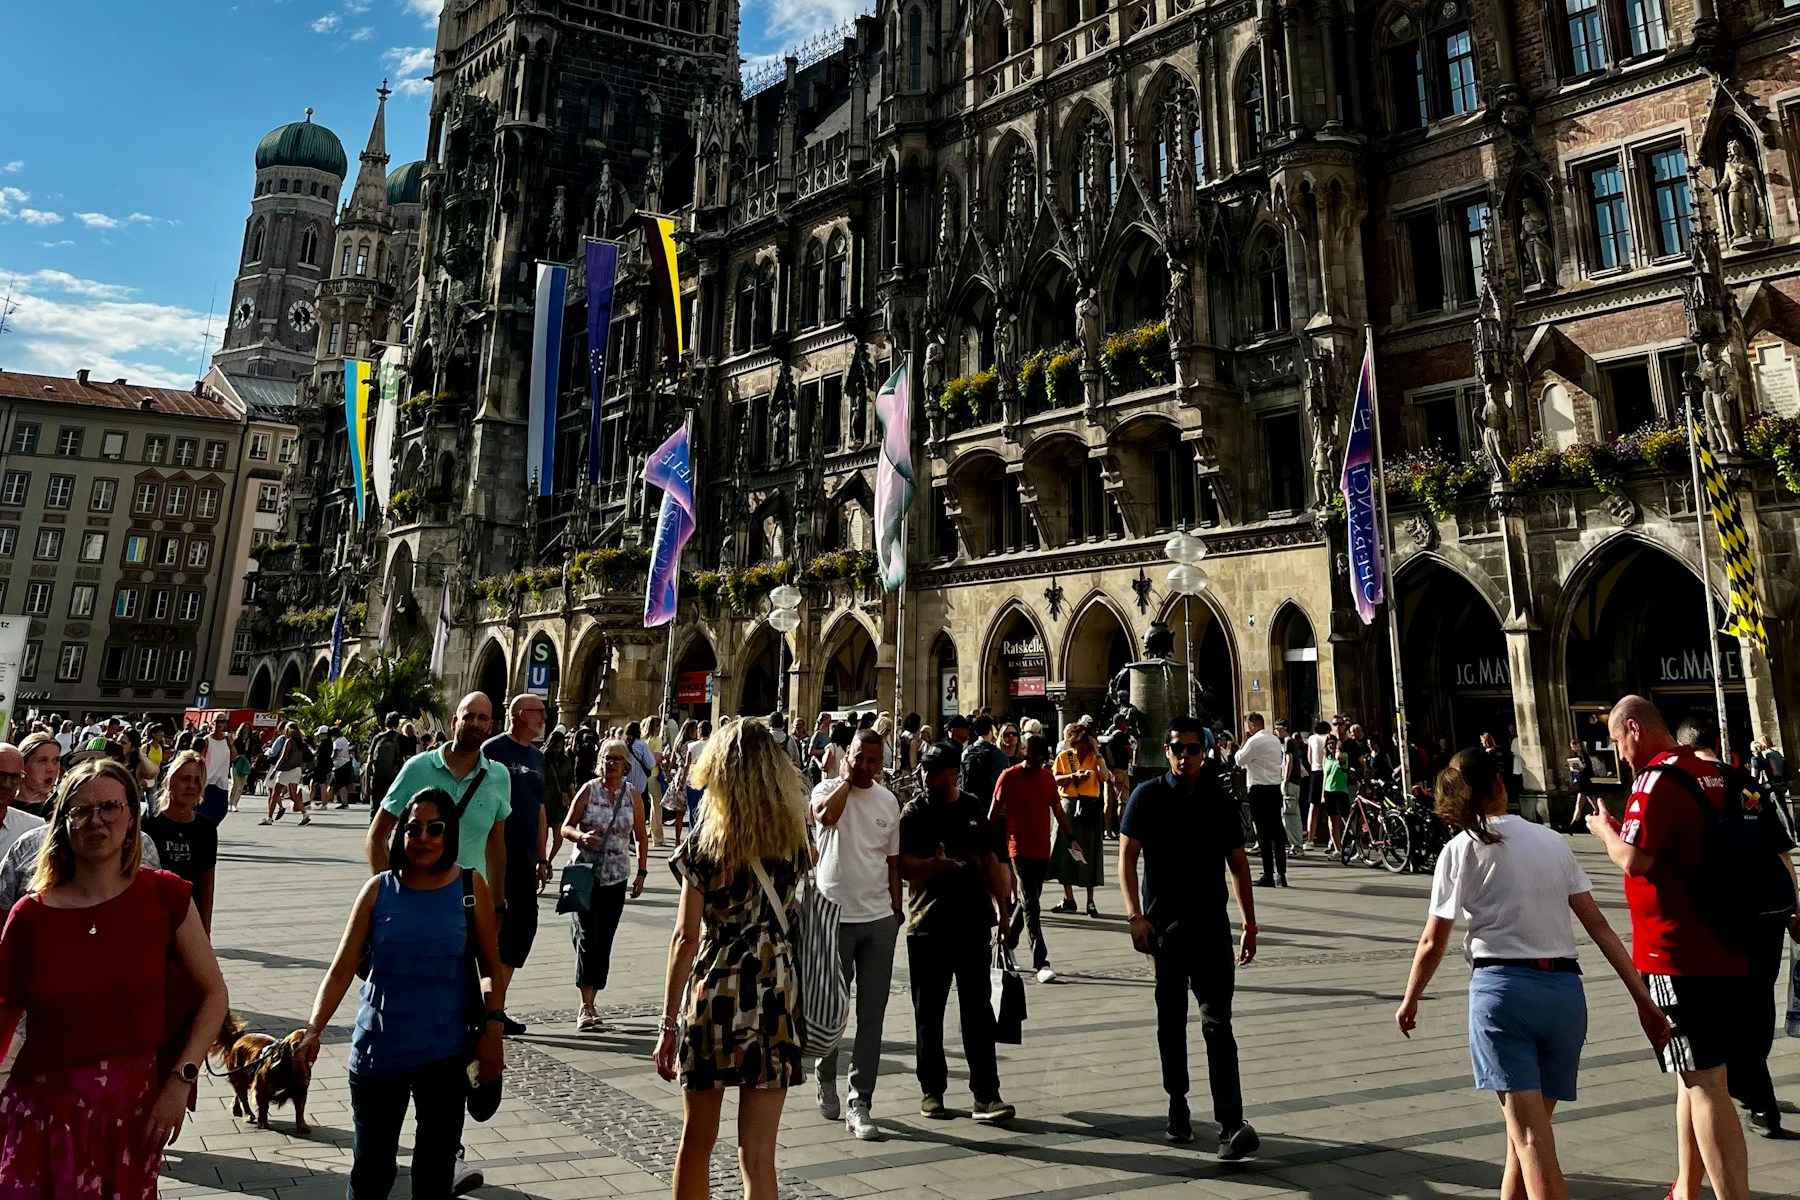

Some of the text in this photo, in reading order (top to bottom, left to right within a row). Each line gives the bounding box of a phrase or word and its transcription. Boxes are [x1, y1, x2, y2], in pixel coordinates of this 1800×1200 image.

[534, 643, 549, 662] S
[1003, 638, 1045, 655] Ratskelle
[532, 667, 547, 686] U
[199, 681, 211, 695] S
[197, 697, 208, 709] U
